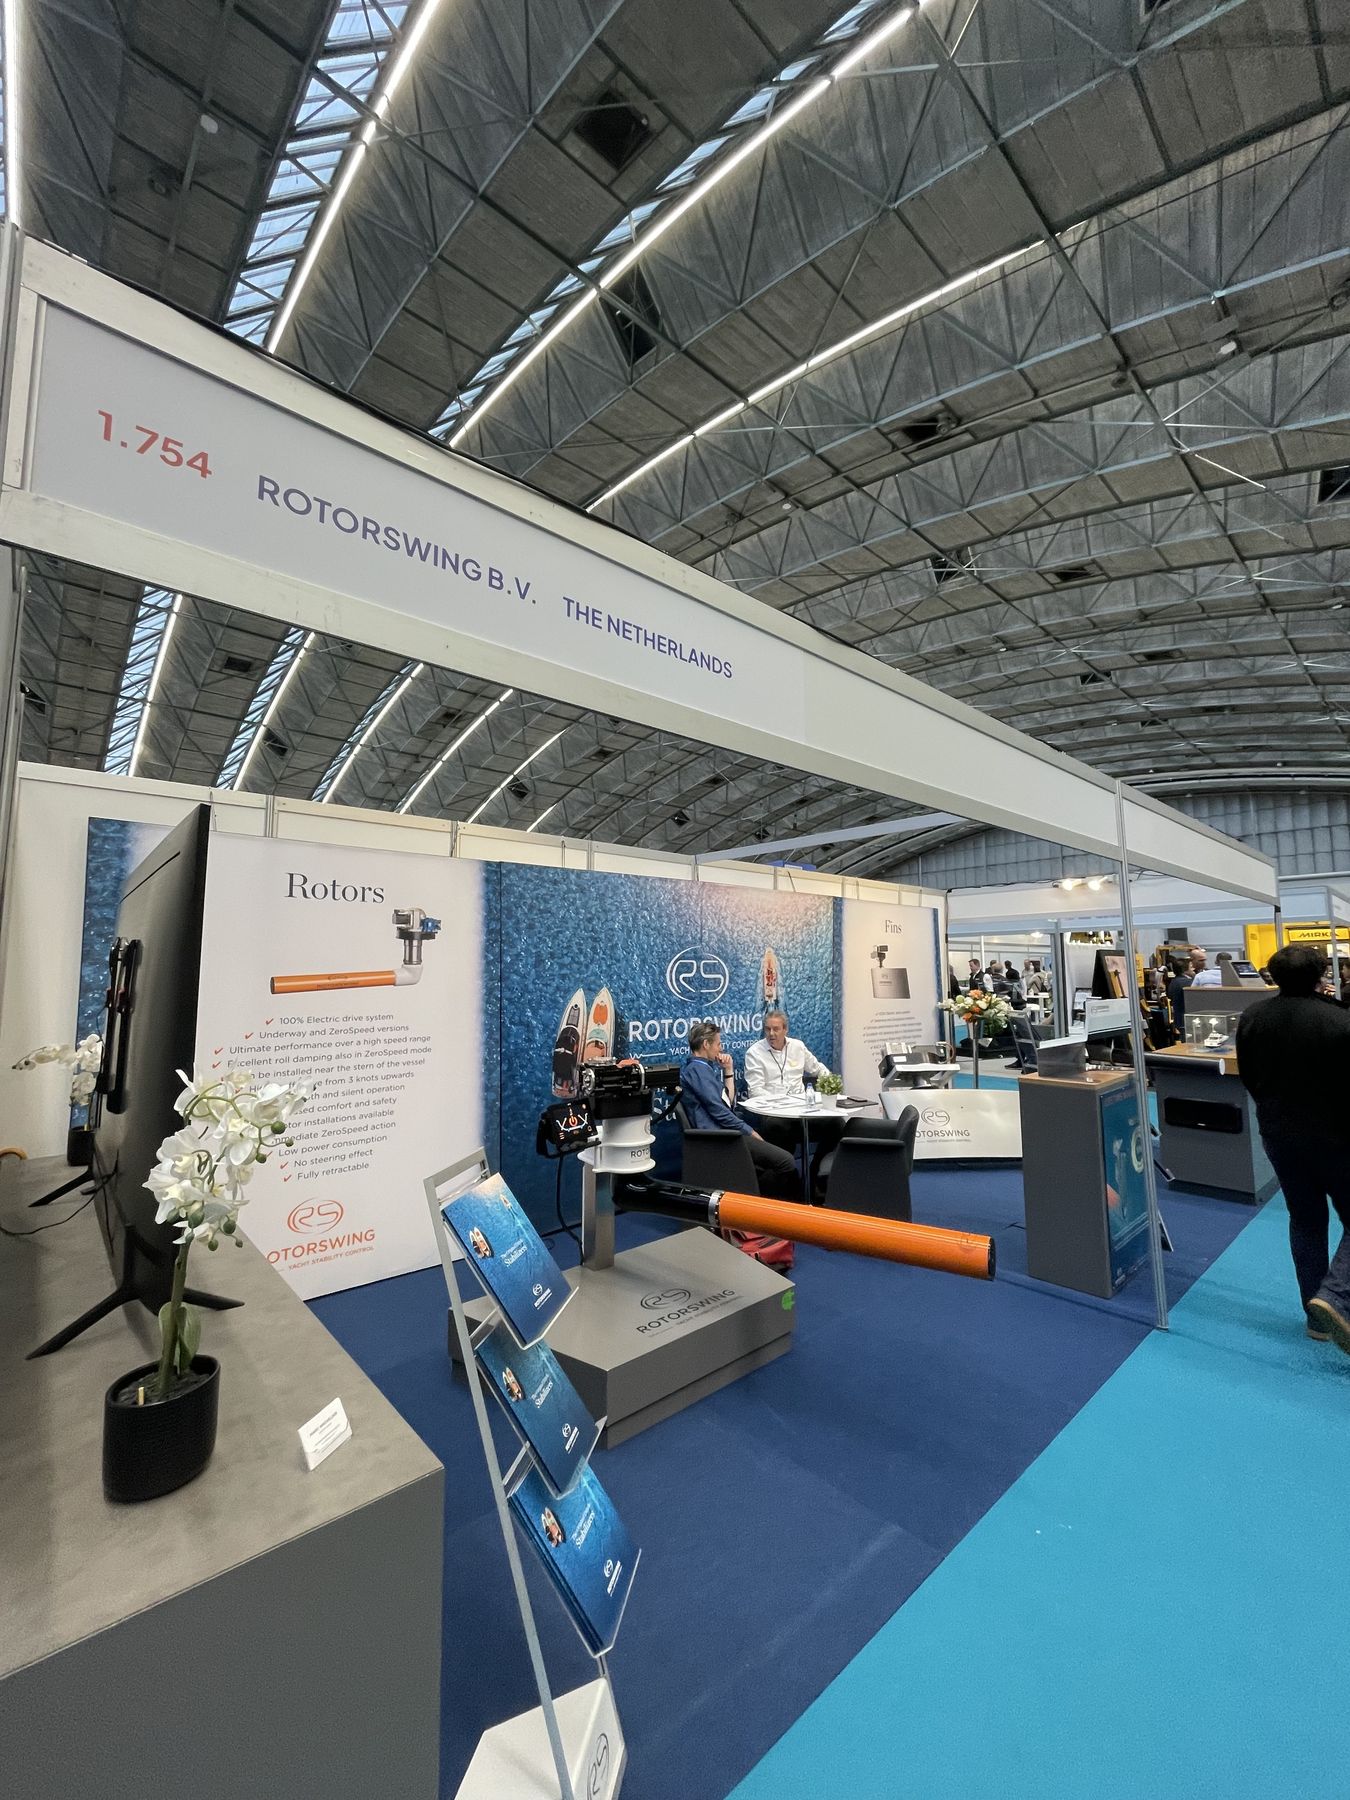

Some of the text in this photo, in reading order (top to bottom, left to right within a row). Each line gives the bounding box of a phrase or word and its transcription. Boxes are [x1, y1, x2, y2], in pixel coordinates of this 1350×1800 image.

[98, 409, 213, 479] 1.754
[257, 474, 537, 604] ROTORSWING B.V.
[563, 596, 733, 679] THE NETHERLANDS
[283, 872, 386, 904] Rotors
[884, 919, 903, 934] Fins
[280, 1013, 394, 1025] 100% Electric drive system
[628, 1013, 763, 1043] ROTOWING
[259, 1024, 409, 1039] Underway and ZeroSpeed versions
[229, 1045, 272, 1054] Ultimate
[274, 1041, 332, 1052] performance
[363, 1038, 381, 1046] high
[384, 1036, 407, 1045] speed
[410, 1035, 431, 1043] range
[227, 1058, 272, 1068] Ecellent
[292, 1055, 332, 1063] damping
[335, 1052, 352, 1060] also
[364, 1048, 408, 1058] ZeroSpeed
[410, 1046, 432, 1054] mode
[258, 1071, 270, 1079] be
[274, 1068, 312, 1077] installed
[314, 1066, 334, 1074] near
[354, 1063, 374, 1071] stern
[387, 1060, 400, 1068] the
[402, 1058, 425, 1066] vessel
[325, 1078, 345, 1086] from
[381, 1071, 414, 1081] upwards
[322, 1091, 339, 1099] and
[341, 1088, 364, 1096] silent
[367, 1085, 405, 1095] operation
[317, 1102, 351, 1113] comfort
[354, 1099, 370, 1108] and
[372, 1097, 397, 1107] safety
[304, 1115, 357, 1127] installations
[359, 1110, 395, 1121] available
[321, 1124, 368, 1138] ZeroSpeed
[371, 1121, 396, 1130] action
[914, 1129, 970, 1138] OTORSWING
[278, 1135, 388, 1157] Low power consumption
[294, 1149, 373, 1168] No steering effect
[297, 1162, 370, 1181] Fully retractable
[266, 1229, 376, 1264] OTORSWING
[636, 1289, 735, 1333] ROTORSWING
